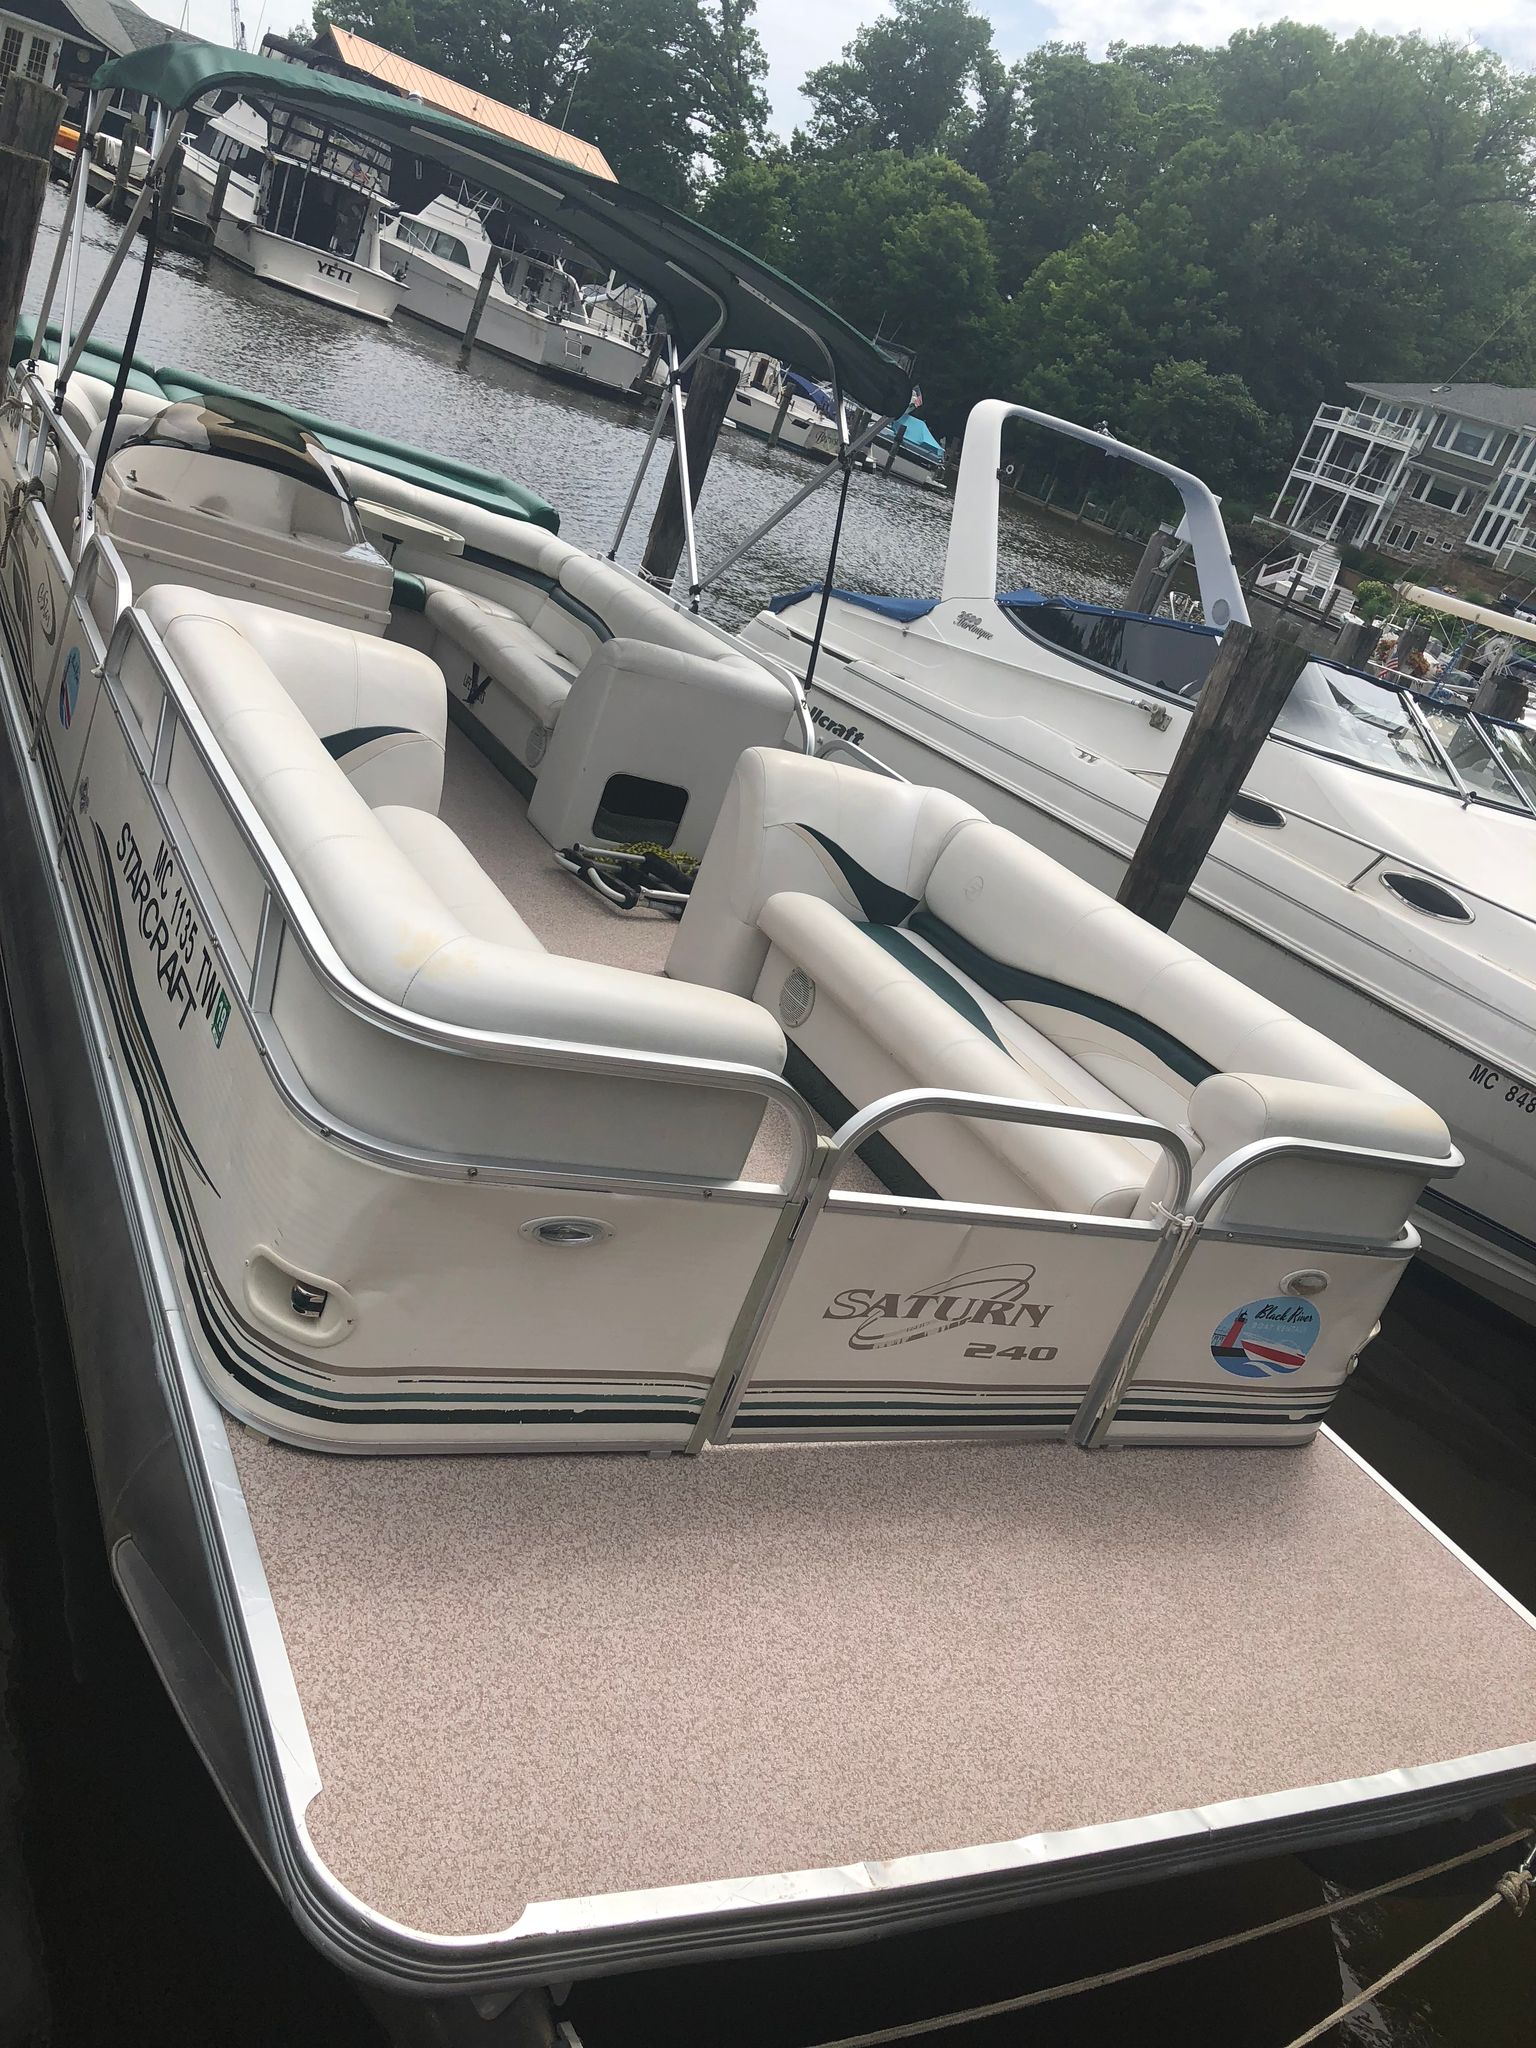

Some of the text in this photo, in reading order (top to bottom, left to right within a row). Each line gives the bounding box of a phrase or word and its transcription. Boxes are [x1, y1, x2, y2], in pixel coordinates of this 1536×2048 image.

[317, 260, 353, 283] YETI
[808, 706, 865, 746] llcraft
[117, 822, 198, 1031] STARCRAFT
[153, 840, 221, 1020] MC 1135 TW
[1469, 1063, 1499, 1090] MC
[822, 1288, 1054, 1329] SATURN
[1255, 1304, 1313, 1324] Black River
[964, 1342, 1058, 1361] 240
